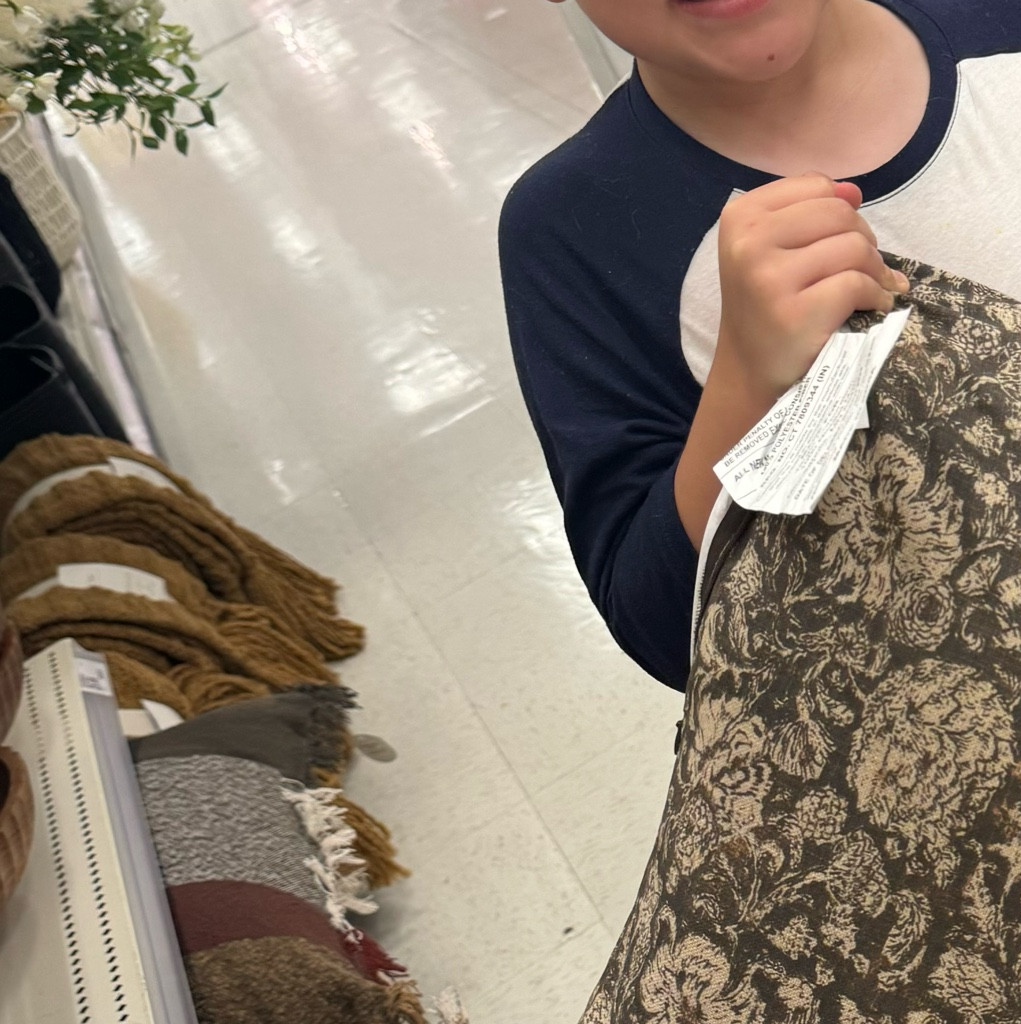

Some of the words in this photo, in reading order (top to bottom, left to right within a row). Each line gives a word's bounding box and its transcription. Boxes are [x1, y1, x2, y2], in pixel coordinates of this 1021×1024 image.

[789, 429, 798, 442] CT
[796, 385, 819, 424] 7809344
[817, 365, 830, 382] (IN)
[724, 457, 735, 467] BE
[735, 431, 769, 458] REMOVED
[772, 406, 800, 453] POLYESTER
